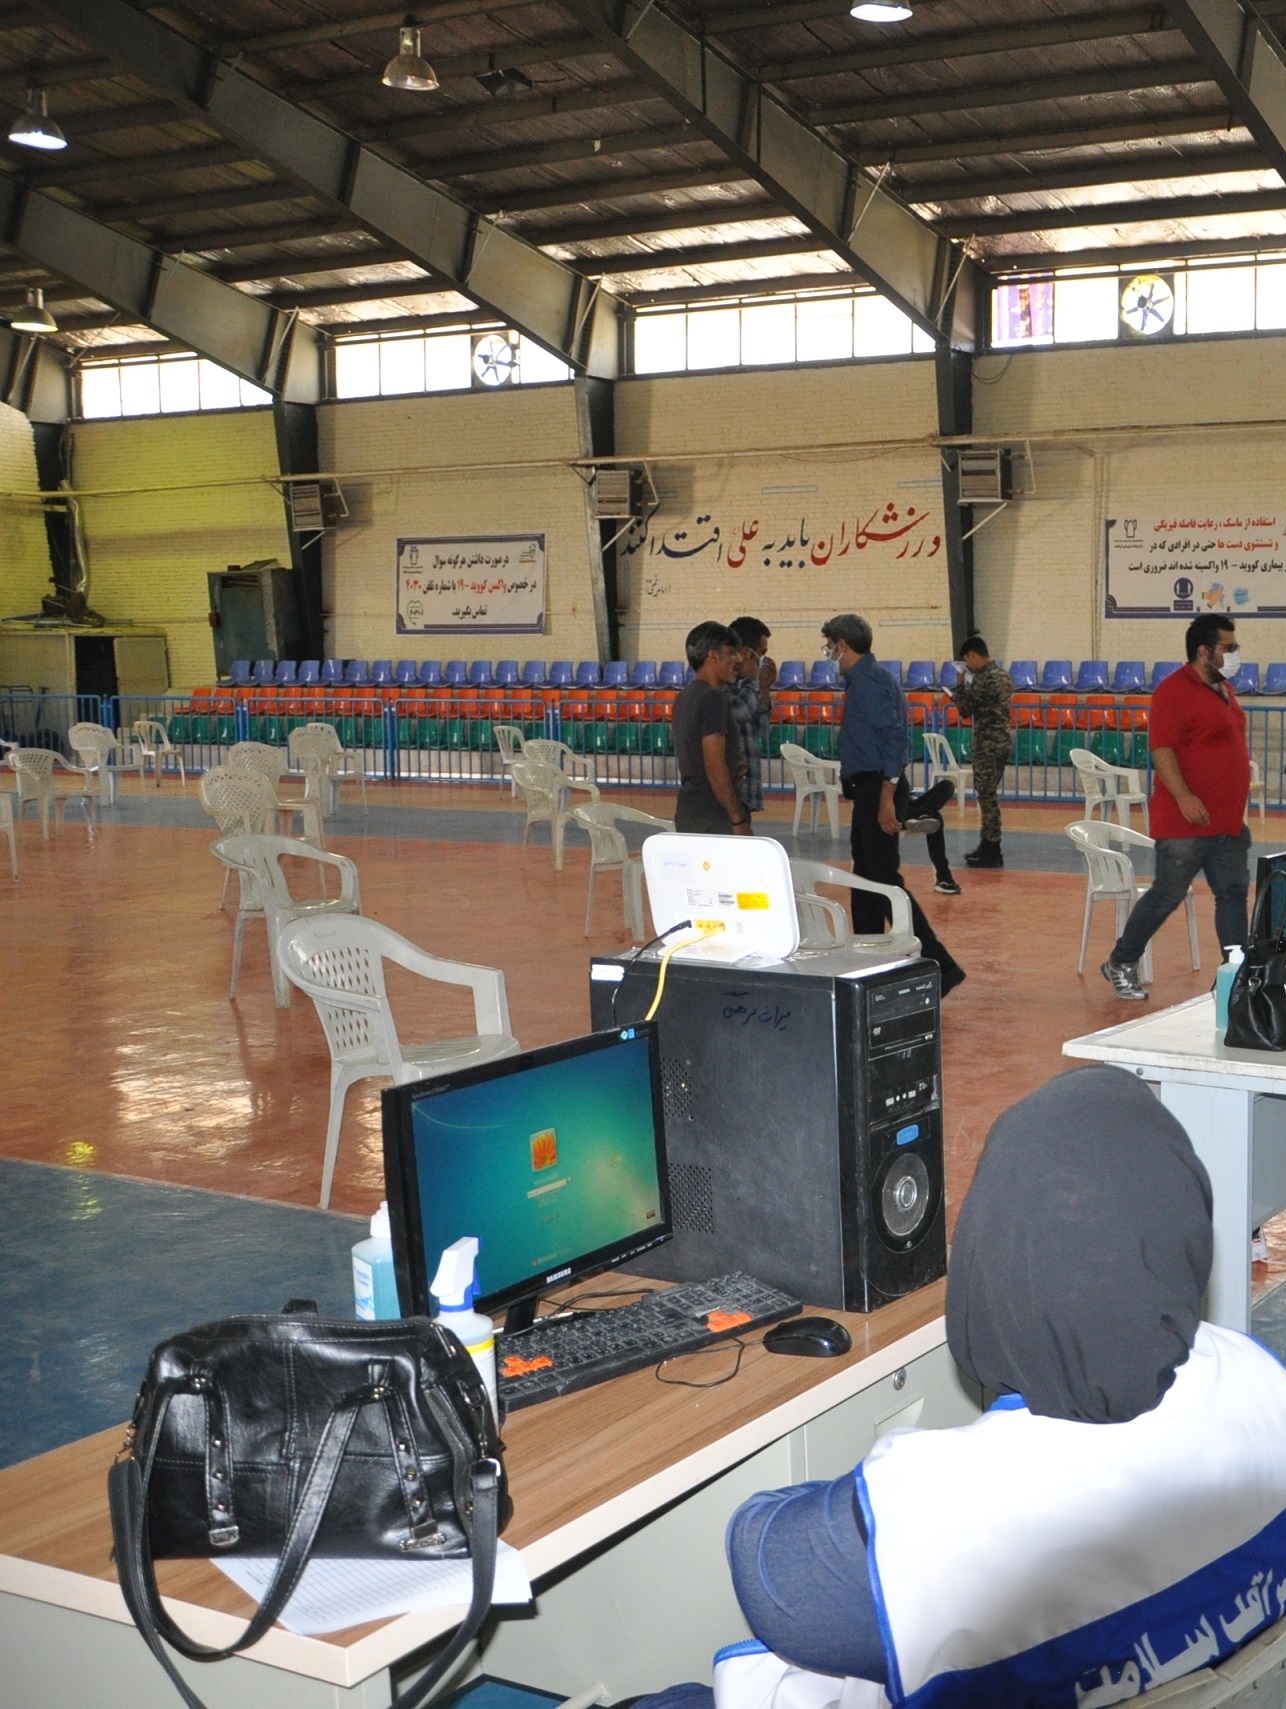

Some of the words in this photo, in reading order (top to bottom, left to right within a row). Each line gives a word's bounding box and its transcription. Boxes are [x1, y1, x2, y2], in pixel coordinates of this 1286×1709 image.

[1153, 517, 1177, 532] فیزیکی
[1178, 517, 1197, 528] فاصله
[1197, 517, 1218, 531] رعایت
[1222, 517, 1243, 528] ماسک
[1244, 517, 1251, 530] از
[1251, 516, 1276, 527] استفاده
[619, 502, 661, 557] کنند
[811, 502, 942, 566] ورزشکاران
[650, 513, 723, 563] اقتدا
[727, 519, 760, 569] علی
[777, 516, 810, 569] باید
[1158, 540, 1167, 550] که
[1217, 539, 1225, 549] ها
[1226, 540, 1243, 549] دست
[1149, 541, 1158, 553] در
[1167, 539, 1191, 553] افرادی
[1191, 541, 1200, 553] در
[1200, 540, 1216, 552] حتی
[467, 553, 484, 568] داشتن
[761, 540, 776, 567] به
[485, 555, 502, 568] صورت
[502, 555, 509, 568] در
[1128, 561, 1143, 571] است
[1143, 560, 1168, 574] ضروری
[1168, 560, 1179, 571] اند
[1179, 560, 1193, 571] شده
[1220, 559, 1229, 571] ۱۹
[1239, 559, 1260, 573] کووید
[1260, 559, 1284, 573] بیماری
[423, 579, 435, 595] تلفن
[435, 579, 451, 595] شماره
[470, 579, 487, 594] کووید
[488, 578, 507, 593] واکسن
[508, 577, 529, 593] خصوص
[529, 580, 536, 593] در
[472, 604, 488, 619] تماس
[546, 1267, 572, 1284] SAMSUNG
